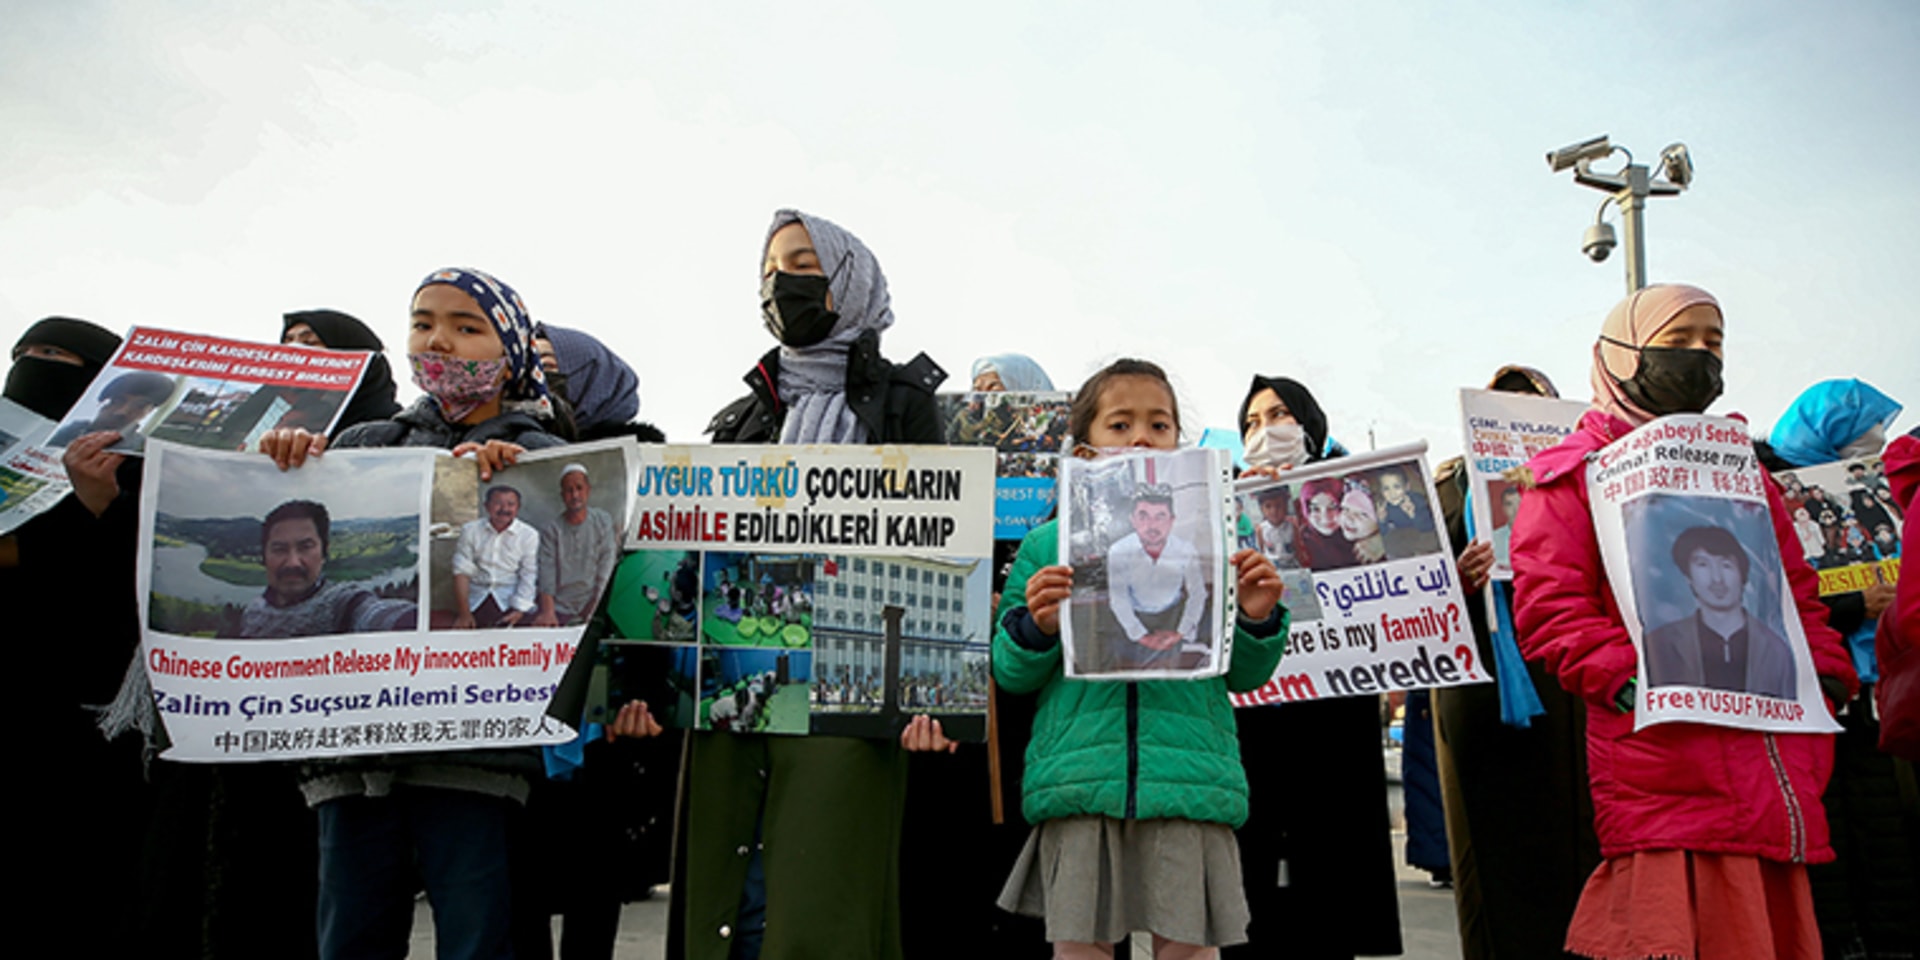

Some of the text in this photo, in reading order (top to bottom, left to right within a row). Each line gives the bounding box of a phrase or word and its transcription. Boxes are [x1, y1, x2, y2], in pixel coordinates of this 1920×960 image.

[230, 363, 294, 381] SERBEST
[1653, 443, 1720, 466] Release
[1723, 453, 1748, 473] my
[719, 461, 799, 498] TÜRKÜ
[805, 466, 961, 505] ÇOCUKLARIN
[636, 505, 956, 547] ASİMİLE EDİLDİKLERİ KAMP
[1317, 622, 1341, 651] is
[1344, 622, 1378, 657] my
[1380, 602, 1461, 643] family?
[150, 647, 223, 678] Chinese
[226, 655, 330, 679] Government
[333, 648, 392, 674] Release
[394, 647, 421, 676] My
[424, 645, 496, 670] innocent
[499, 642, 551, 672] Family
[1324, 644, 1479, 697] nerede?
[239, 697, 283, 721] Çin
[289, 693, 371, 716] Suçsuz
[376, 684, 458, 708] Ailemi
[1645, 690, 1804, 721] Free YUSUF YAKUP
